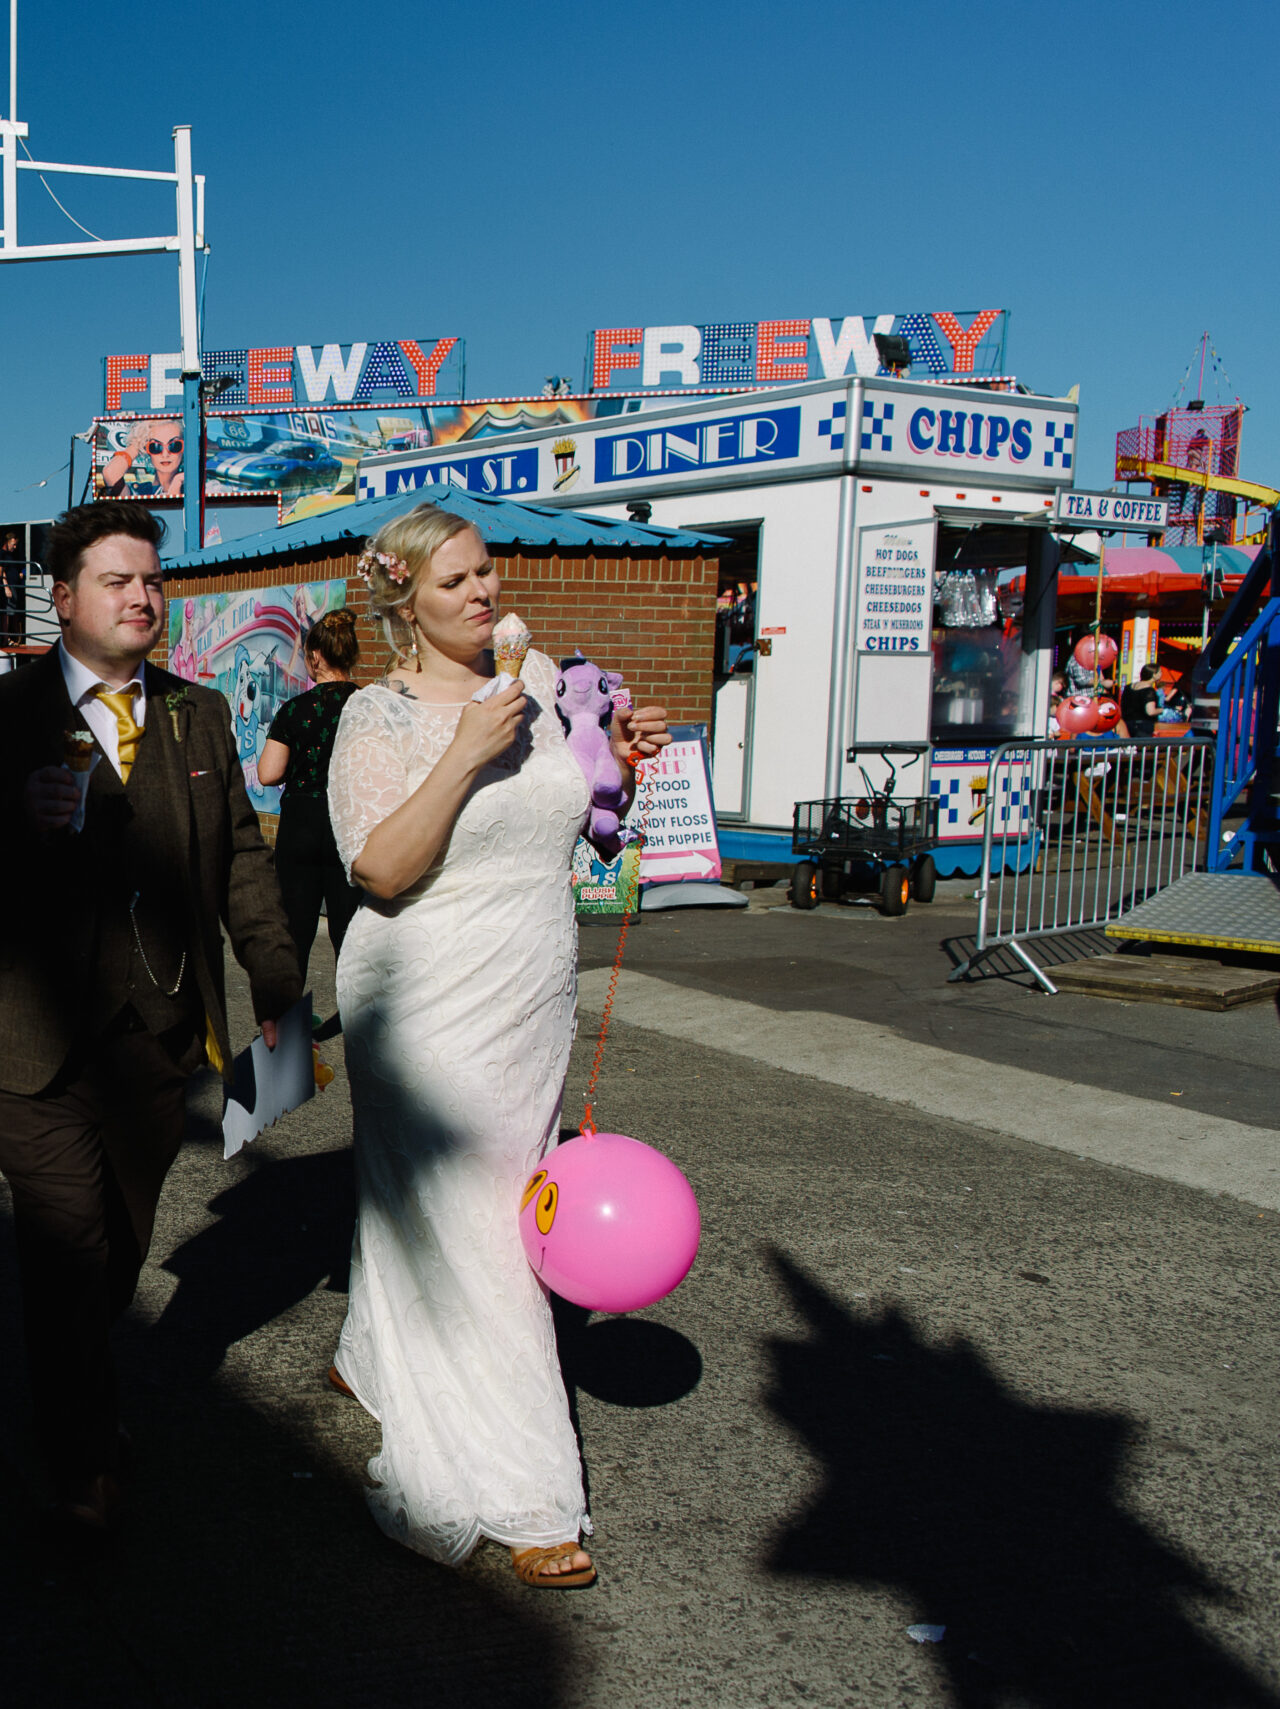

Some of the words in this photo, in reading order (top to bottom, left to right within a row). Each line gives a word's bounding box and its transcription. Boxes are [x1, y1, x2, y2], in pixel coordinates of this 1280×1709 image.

[594, 309, 1002, 389] FREEWAY
[907, 407, 1033, 463] CHIPS
[613, 418, 778, 476] DINER
[482, 456, 528, 493] ST.
[1067, 496, 1092, 516] TEA
[1098, 499, 1108, 518] &
[1113, 500, 1162, 522] COFFEE
[876, 549, 892, 560] HOT
[897, 550, 918, 560] DOGS
[866, 566, 926, 578] BEEFGERS
[865, 584, 925, 596] CHEESEBURGERS
[867, 602, 922, 613] CHEESEDOGS
[866, 636, 919, 651] CHIPS
[245, 730, 254, 750] S
[638, 781, 652, 793] OT
[656, 779, 690, 792] FOOD
[637, 797, 688, 812] DO-NUTS
[671, 814, 709, 827] FLOSS
[668, 831, 712, 846] PUPPIE
[603, 871, 616, 886] S
